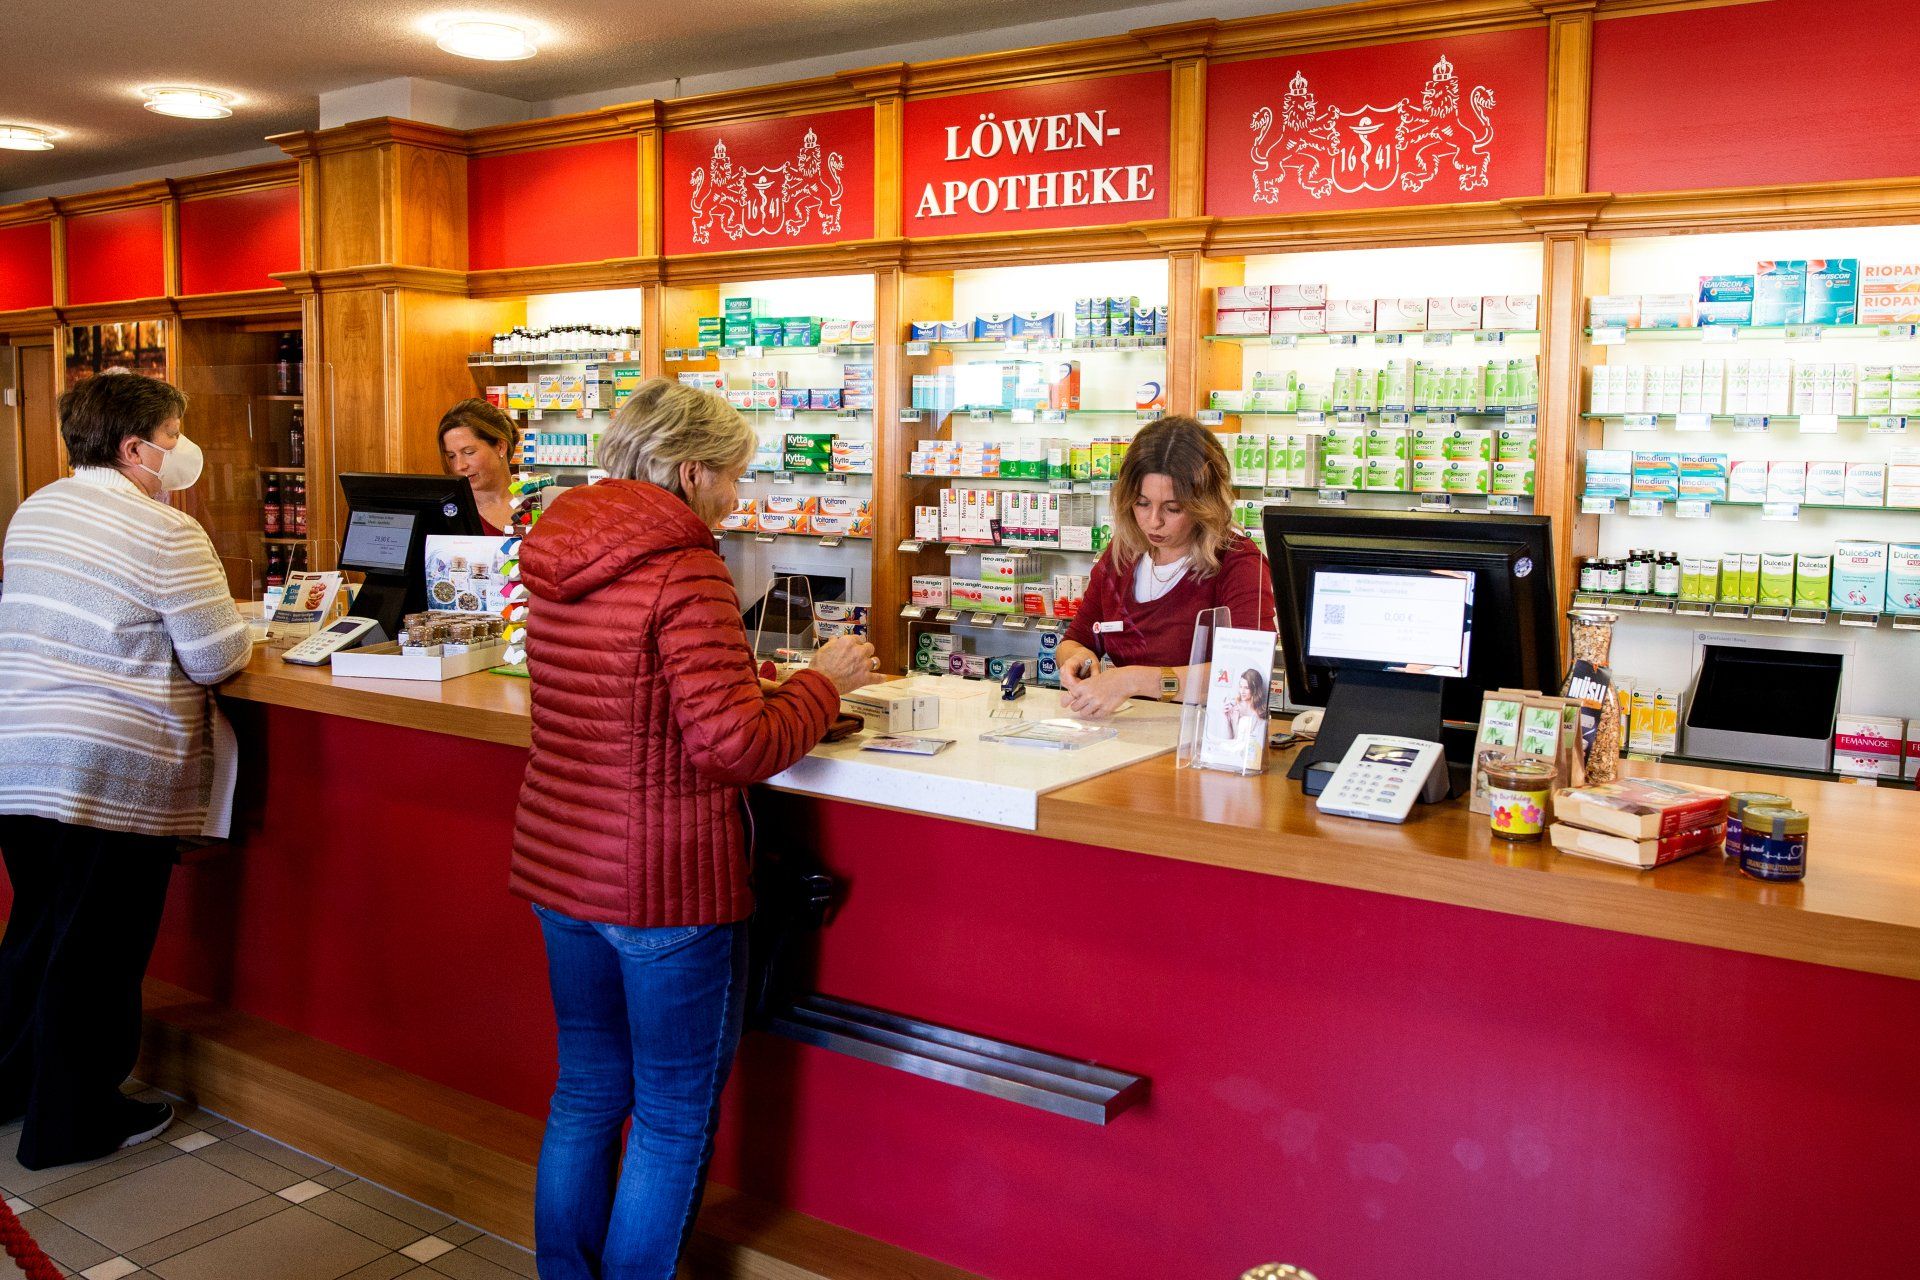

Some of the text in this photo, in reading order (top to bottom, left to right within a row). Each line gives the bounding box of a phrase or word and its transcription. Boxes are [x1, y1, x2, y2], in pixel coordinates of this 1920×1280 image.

[945, 110, 1120, 163] LÖWEN-
[916, 164, 1155, 219] APOTHEKE
[1703, 280, 1743, 288] GAVISCON
[788, 434, 808, 444] Kytta
[786, 453, 806, 464] Kytta
[1636, 454, 1671, 462] Imodium
[762, 514, 785, 522] Voltaren
[815, 516, 838, 524] Voltaren
[1839, 548, 1882, 558] DulceSoft
[1044, 636, 1055, 644] isla
[1044, 662, 1055, 671] isla
[1568, 676, 1607, 704] MÜSLI
[1527, 728, 1554, 736] LEMONGRAS
[1841, 736, 1890, 748] FEMANNOSE
